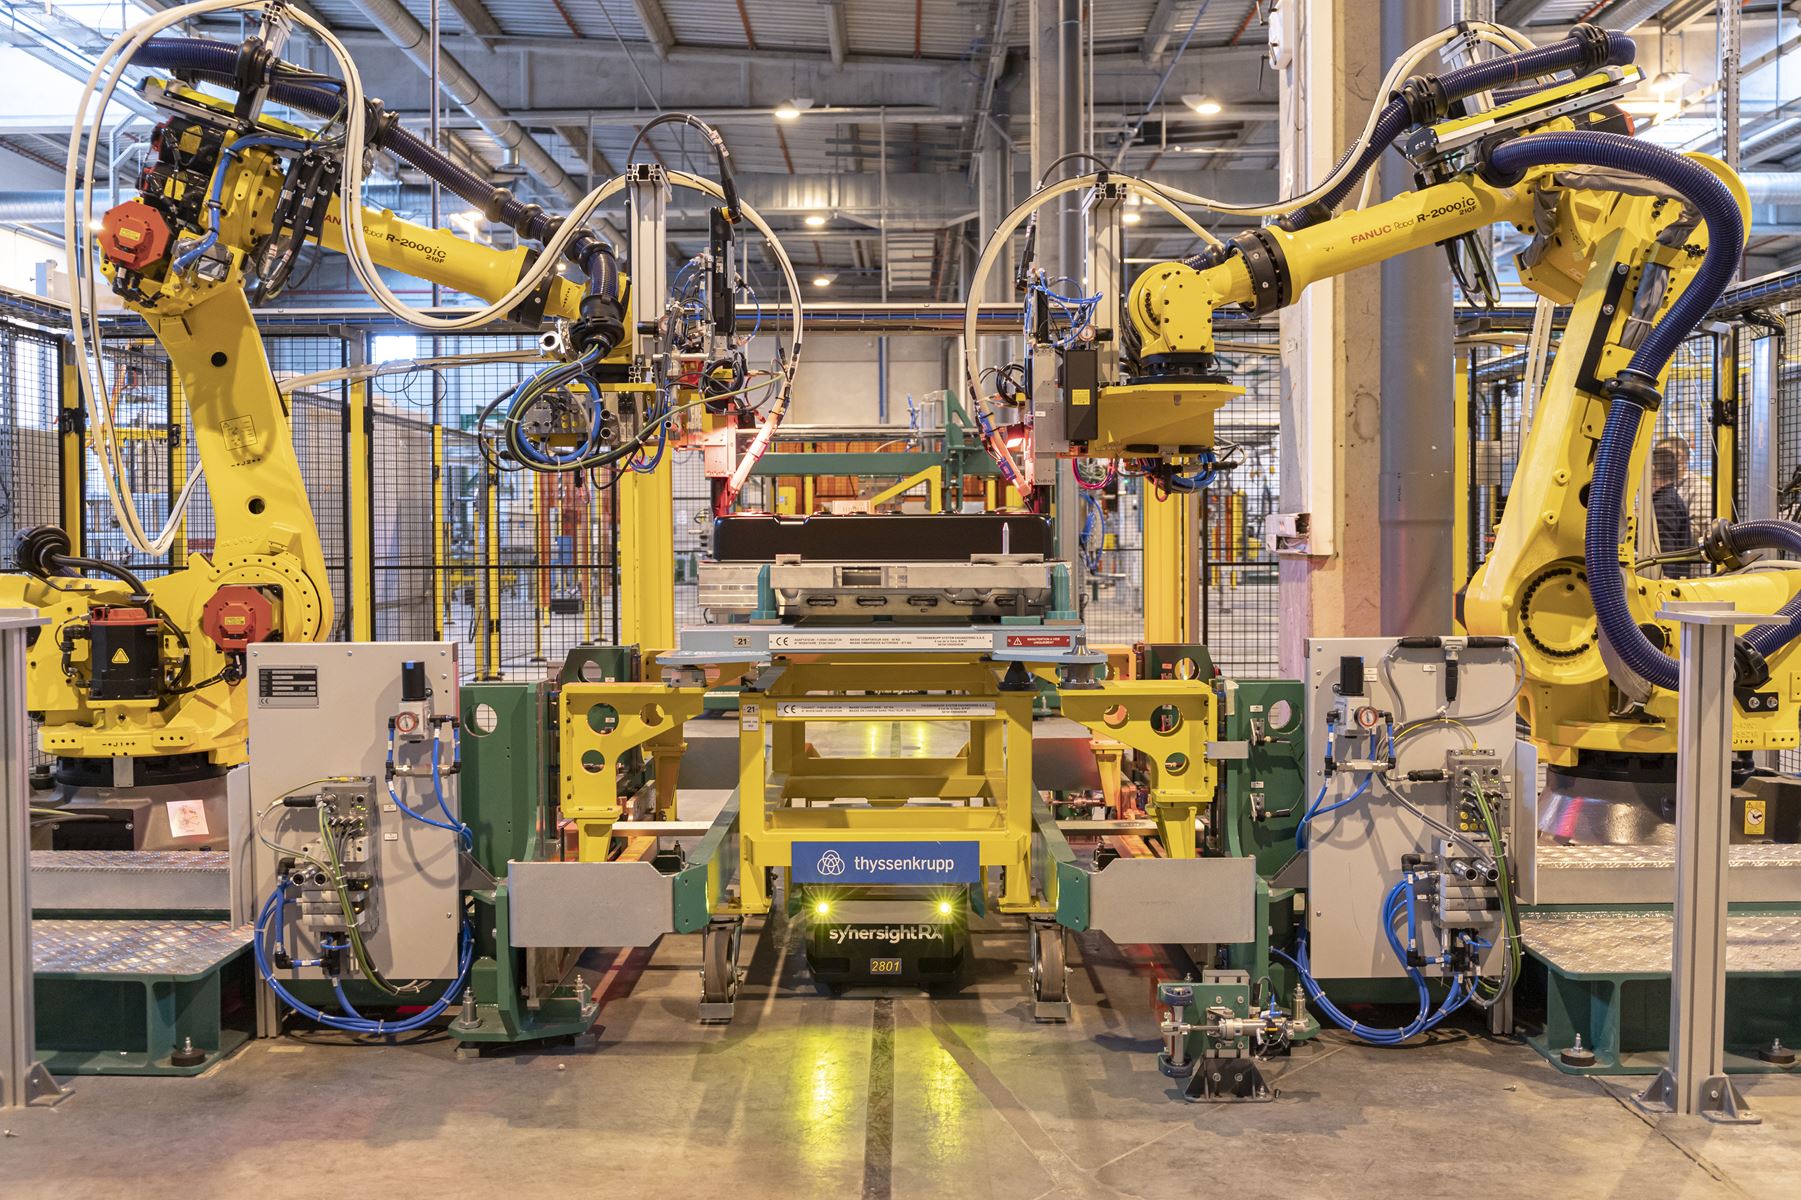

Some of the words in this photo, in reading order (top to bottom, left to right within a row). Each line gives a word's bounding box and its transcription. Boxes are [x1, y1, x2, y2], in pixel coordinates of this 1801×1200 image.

[1459, 205, 1477, 216] 210F
[1351, 225, 1392, 244] FANUC
[1417, 197, 1476, 223] R-2000iC
[386, 233, 447, 259] R-2000iC
[425, 254, 445, 264] 210F
[776, 637, 789, 646] CE
[784, 704, 796, 713] CE
[855, 856, 954, 873] thyssenkrupp
[871, 960, 900, 972] 2801
